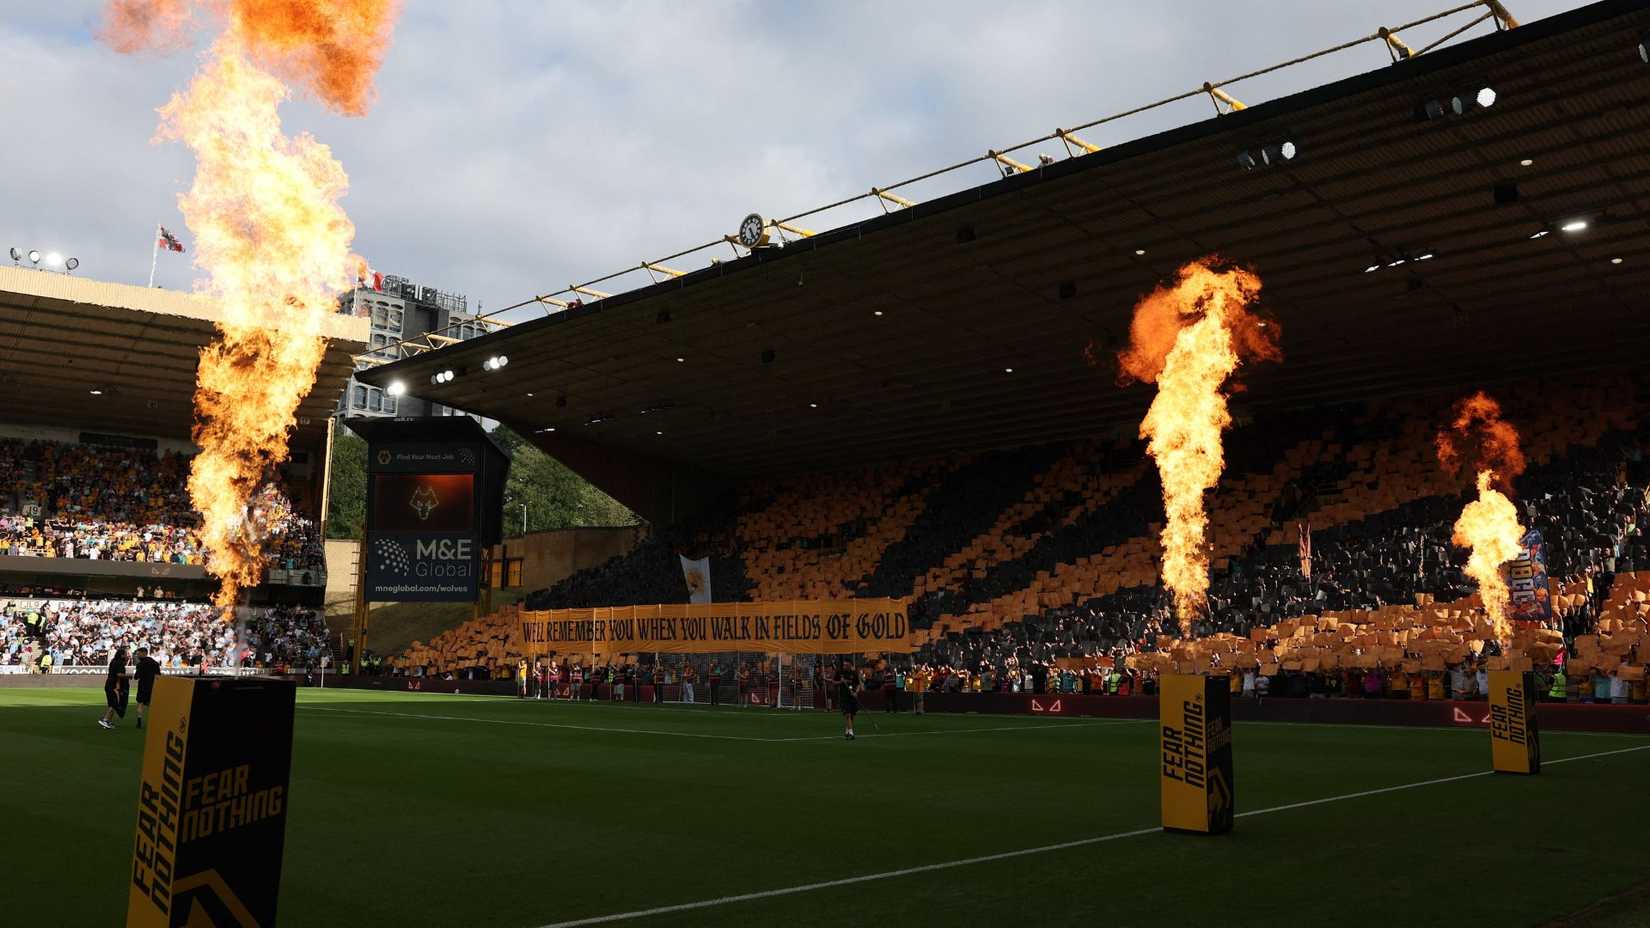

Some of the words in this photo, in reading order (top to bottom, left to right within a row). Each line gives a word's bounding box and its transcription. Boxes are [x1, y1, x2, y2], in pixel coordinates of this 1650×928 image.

[415, 561, 471, 577] Global
[417, 539, 472, 560] M&E
[375, 584, 468, 594] mneglobal.com/wolves
[547, 619, 607, 642] REMEMBER
[609, 618, 634, 641] YOU
[637, 617, 677, 641] WHEN
[681, 617, 706, 641] YOU
[710, 616, 751, 641] WALK
[755, 616, 771, 641] IN
[774, 615, 821, 640] FIELDS
[826, 614, 851, 640] OF
[856, 612, 906, 640] GOLD
[1491, 704, 1508, 741] FEAR
[1507, 688, 1525, 745] NOTHING
[1163, 725, 1184, 781] FEAR
[1184, 701, 1205, 789] NOTHING
[186, 763, 249, 809] FEAR
[134, 781, 160, 898] FEAR
[151, 730, 184, 917] NOTHING
[182, 783, 285, 848] NOTHING
